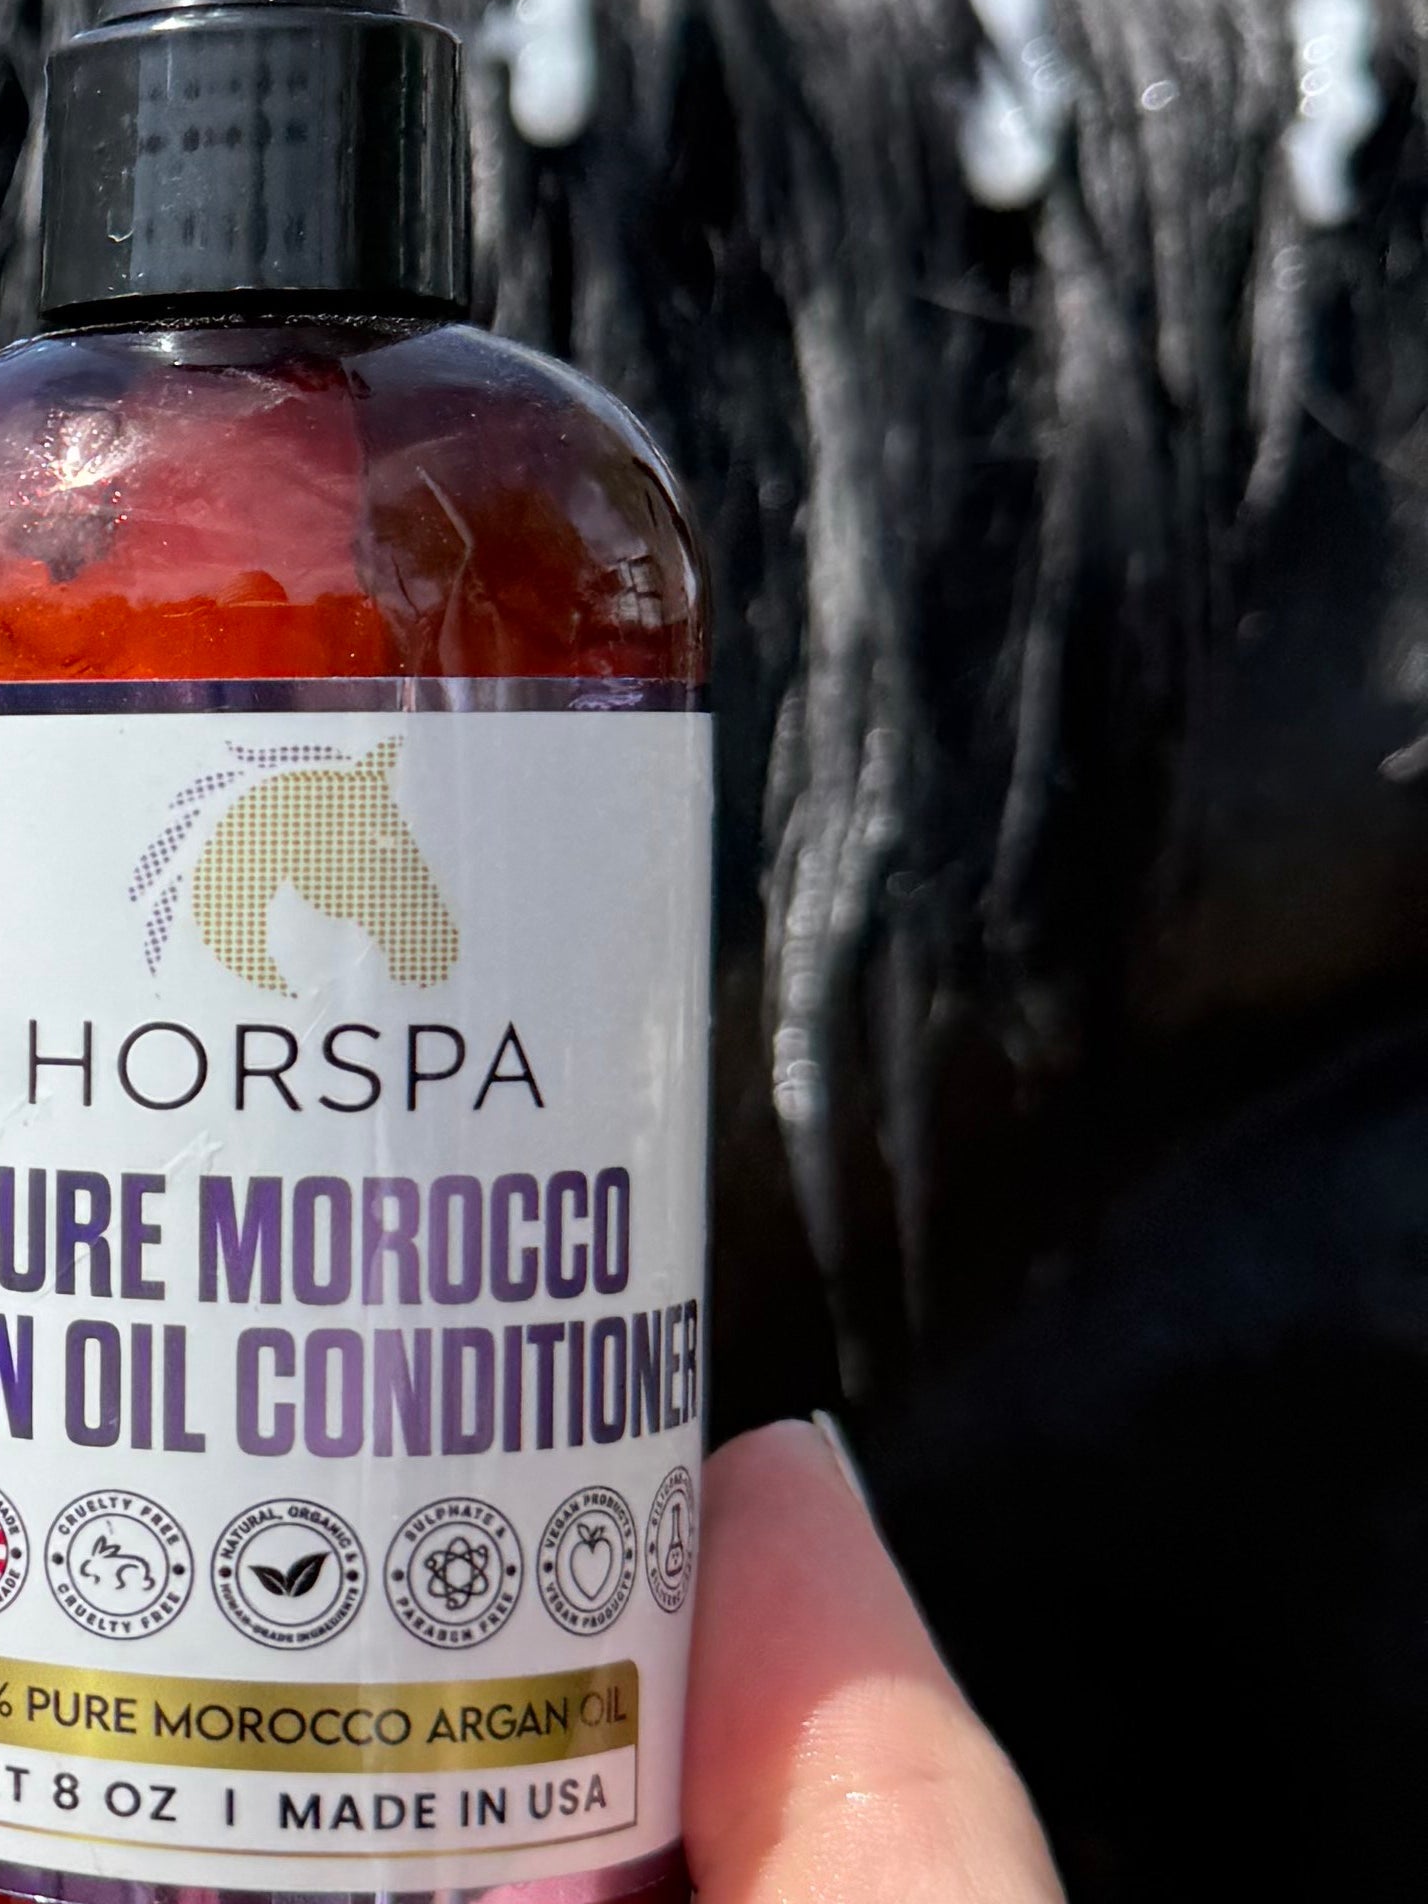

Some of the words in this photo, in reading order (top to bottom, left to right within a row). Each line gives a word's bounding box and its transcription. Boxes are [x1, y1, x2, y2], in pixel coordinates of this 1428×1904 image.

[27, 1018, 546, 1113] HORSPA
[199, 1166, 631, 1306] MOROCCO
[64, 1318, 207, 1454] OIL
[235, 1298, 699, 1459] CONDITIONER
[57, 1497, 133, 1536] CRUELTY
[140, 1505, 180, 1546] FREE
[287, 1505, 352, 1550] ORGANIC
[404, 1504, 495, 1543] SULPHATE
[545, 1500, 581, 1549] VEGAN
[583, 1493, 632, 1538] PRODUCTS
[57, 1583, 132, 1634] CRUELTY
[140, 1591, 181, 1630] FREE
[396, 1596, 474, 1644] PARABEN
[479, 1592, 514, 1633] FREE
[546, 1581, 579, 1627] VEGAN
[581, 1569, 632, 1629] PRODUCTS
[26, 1684, 138, 1736] PURE
[154, 1700, 412, 1747] MOROCCO
[425, 1696, 569, 1745] ARGAN
[579, 1685, 628, 1729] OIL
[52, 1771, 81, 1811] 8
[104, 1780, 178, 1823] OZ
[278, 1791, 437, 1830] MADE
[459, 1786, 507, 1828] IN
[528, 1772, 608, 1821] USA
